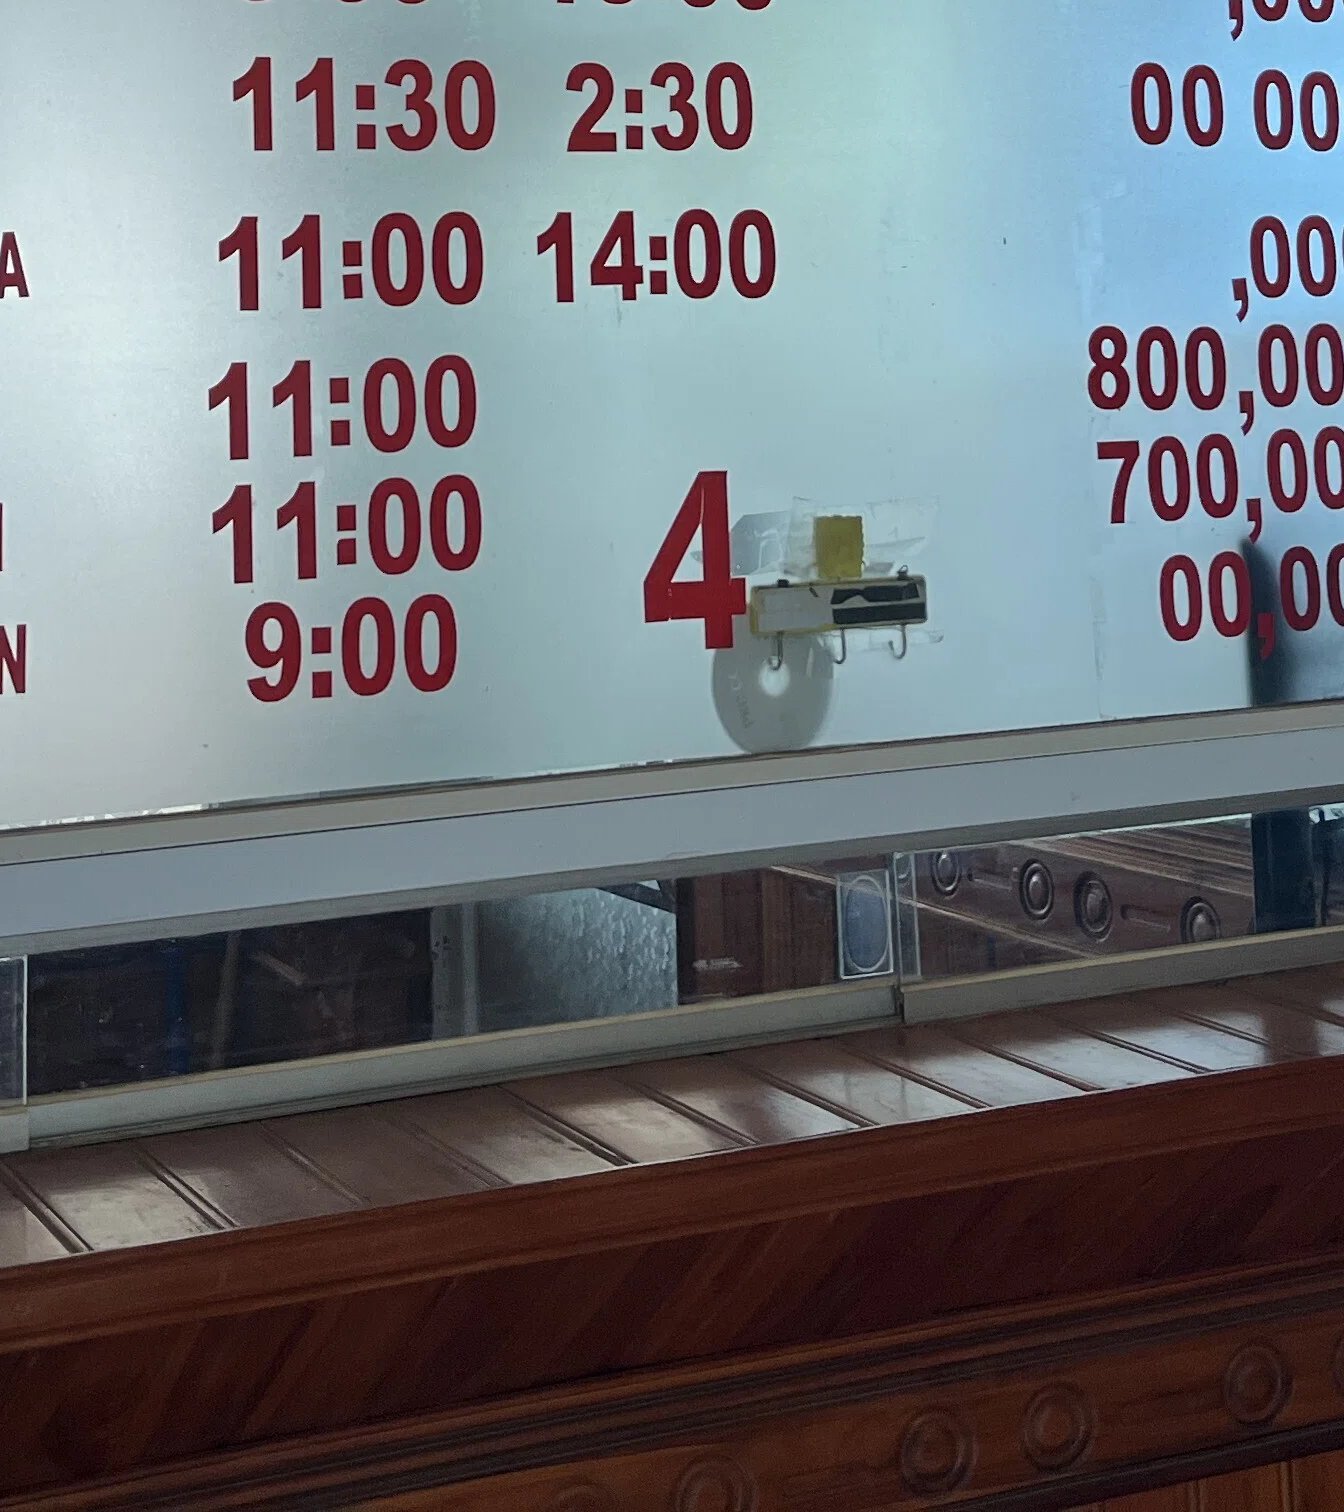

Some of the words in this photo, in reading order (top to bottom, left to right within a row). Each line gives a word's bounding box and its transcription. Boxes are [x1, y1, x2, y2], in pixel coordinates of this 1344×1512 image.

[231, 56, 497, 152] 11:30
[565, 61, 755, 154] 2:30
[218, 210, 485, 312] 11:00
[535, 208, 777, 303] 14:00
[208, 354, 478, 461] 11:00
[211, 473, 483, 586] 11:00
[643, 469, 748, 651] 4
[244, 592, 459, 705] 9:00
